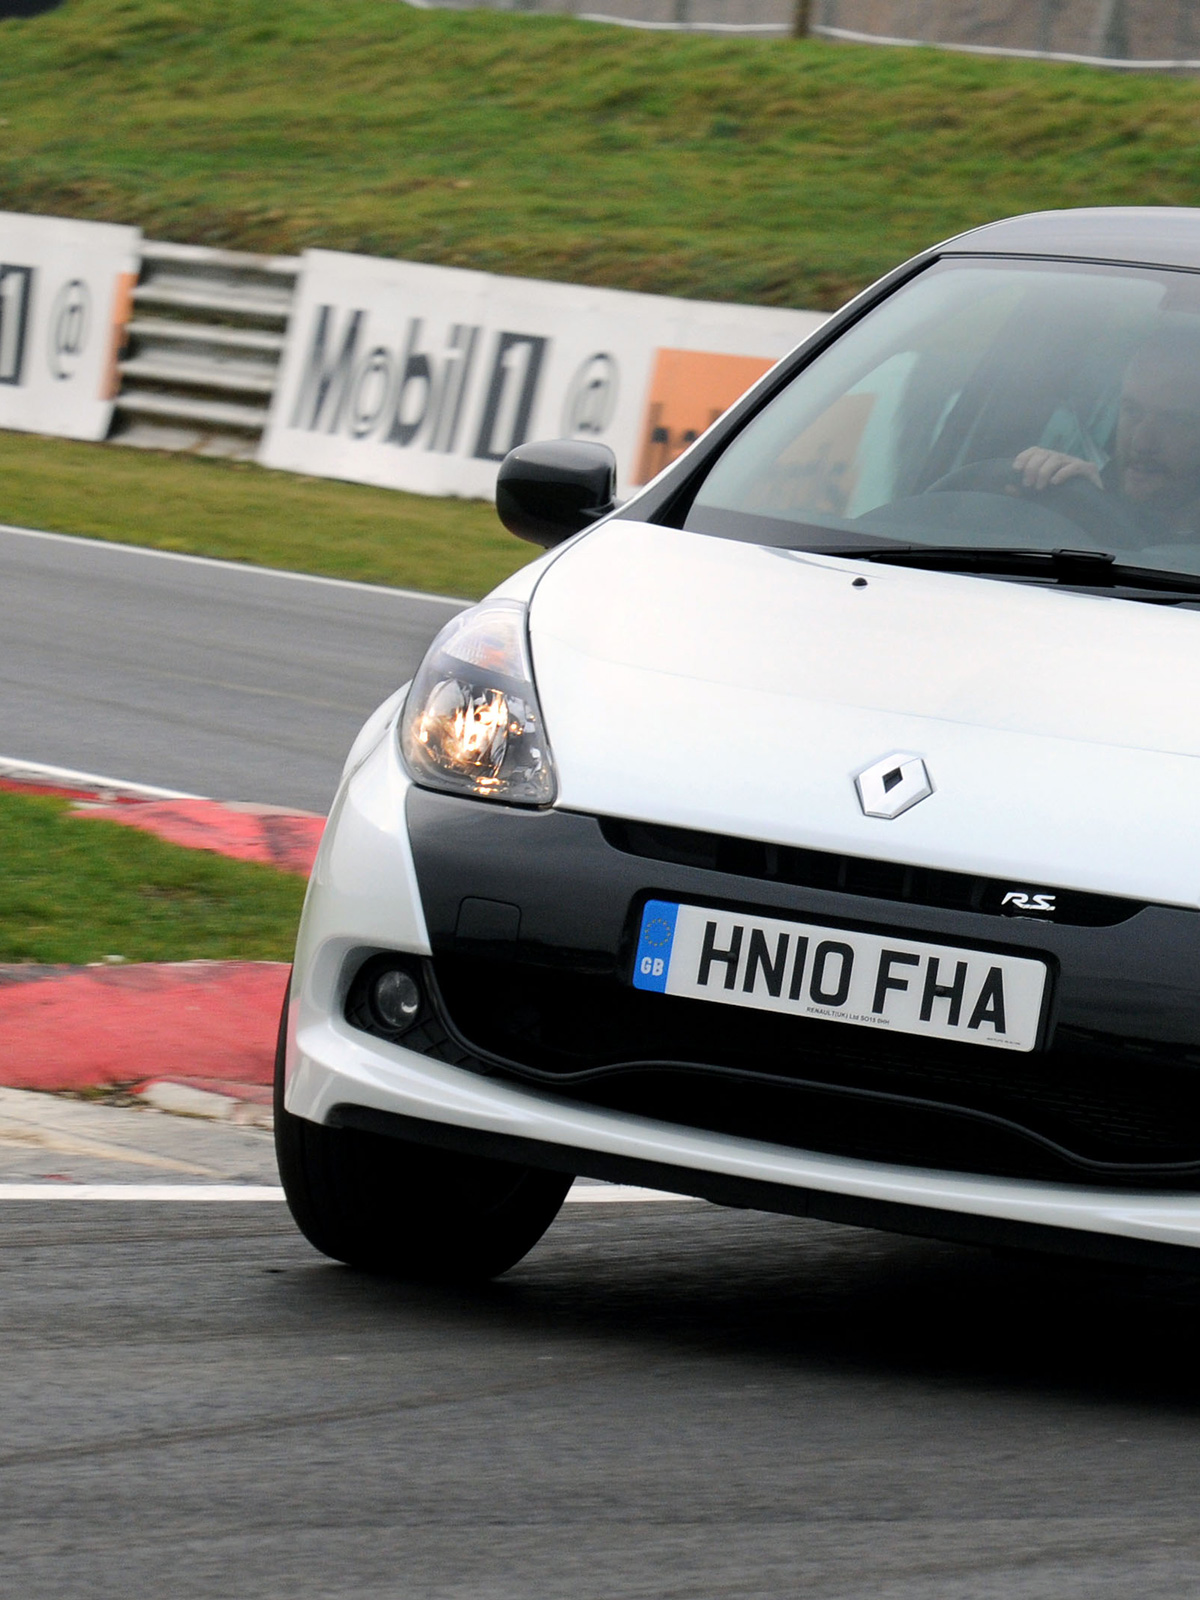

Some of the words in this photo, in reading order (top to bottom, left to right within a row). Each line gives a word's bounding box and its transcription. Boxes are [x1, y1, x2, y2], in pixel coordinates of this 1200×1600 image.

[640, 956, 665, 976] GB
[696, 920, 855, 1008] HN10
[871, 948, 1007, 1034] FHA
